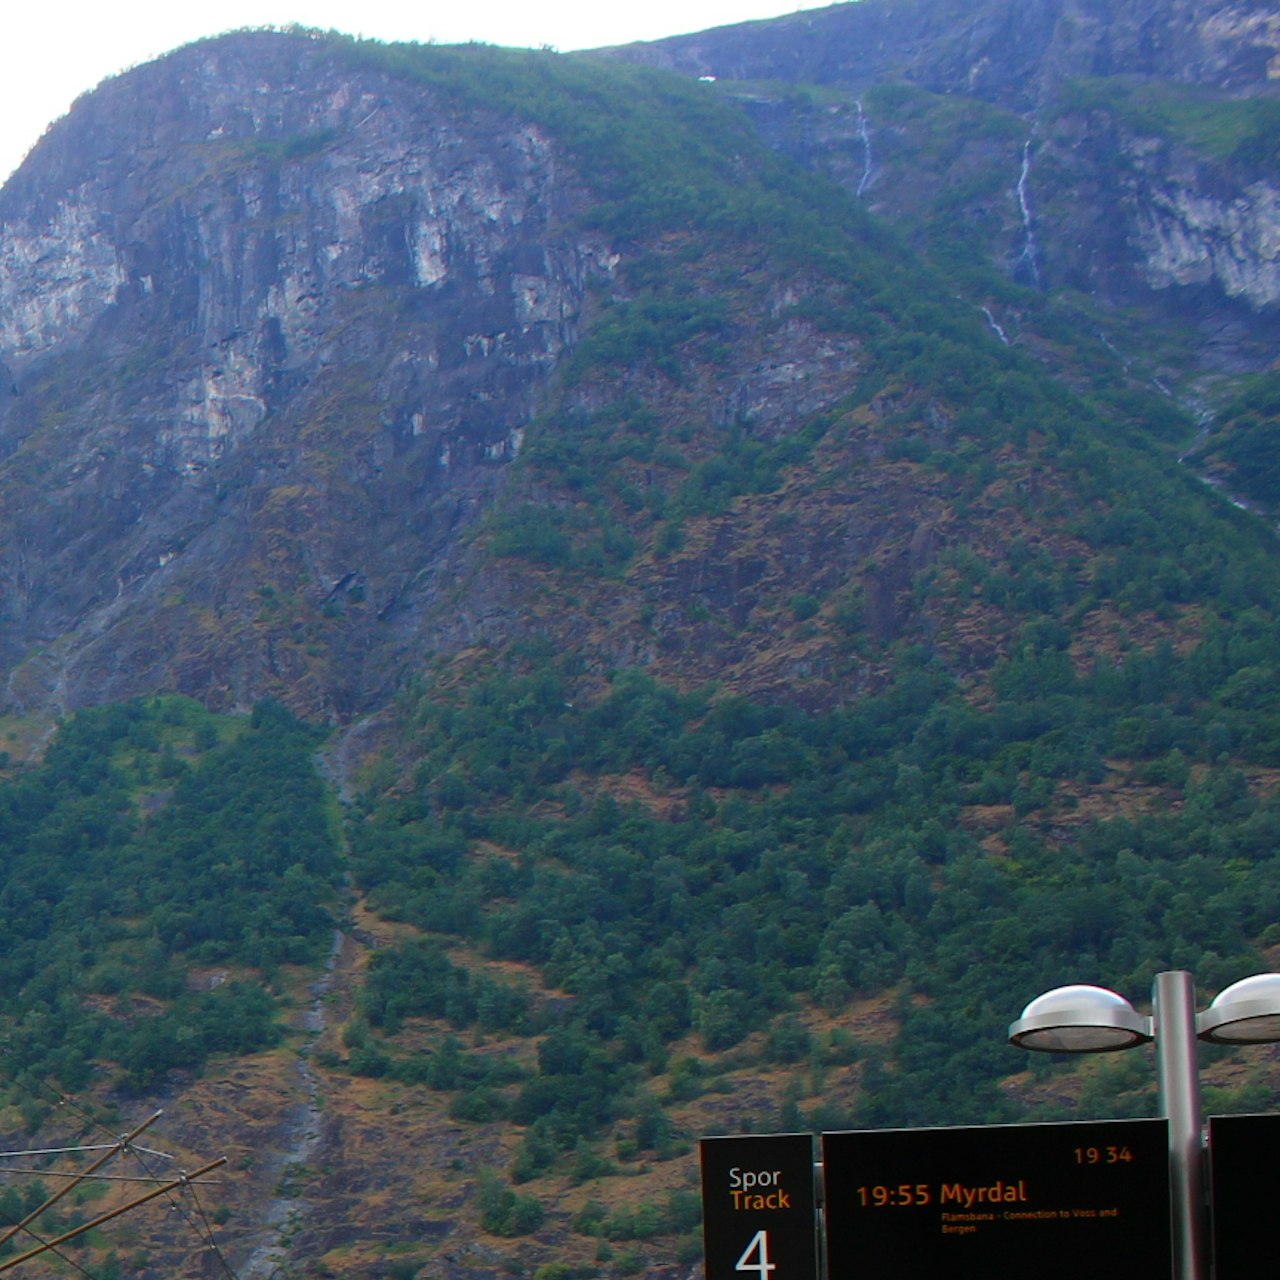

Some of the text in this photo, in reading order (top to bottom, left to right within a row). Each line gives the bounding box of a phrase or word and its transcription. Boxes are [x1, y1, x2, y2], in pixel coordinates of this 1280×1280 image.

[1074, 1146, 1133, 1164] 19 34
[729, 1167, 782, 1192] Spor
[729, 1189, 791, 1210] Track
[857, 1180, 1028, 1208] 19:55 Myrdal
[1003, 1210, 1057, 1221] Connection
[1059, 1209, 1070, 1219] to
[1099, 1207, 1119, 1218] and
[942, 1224, 977, 1235] Bergen
